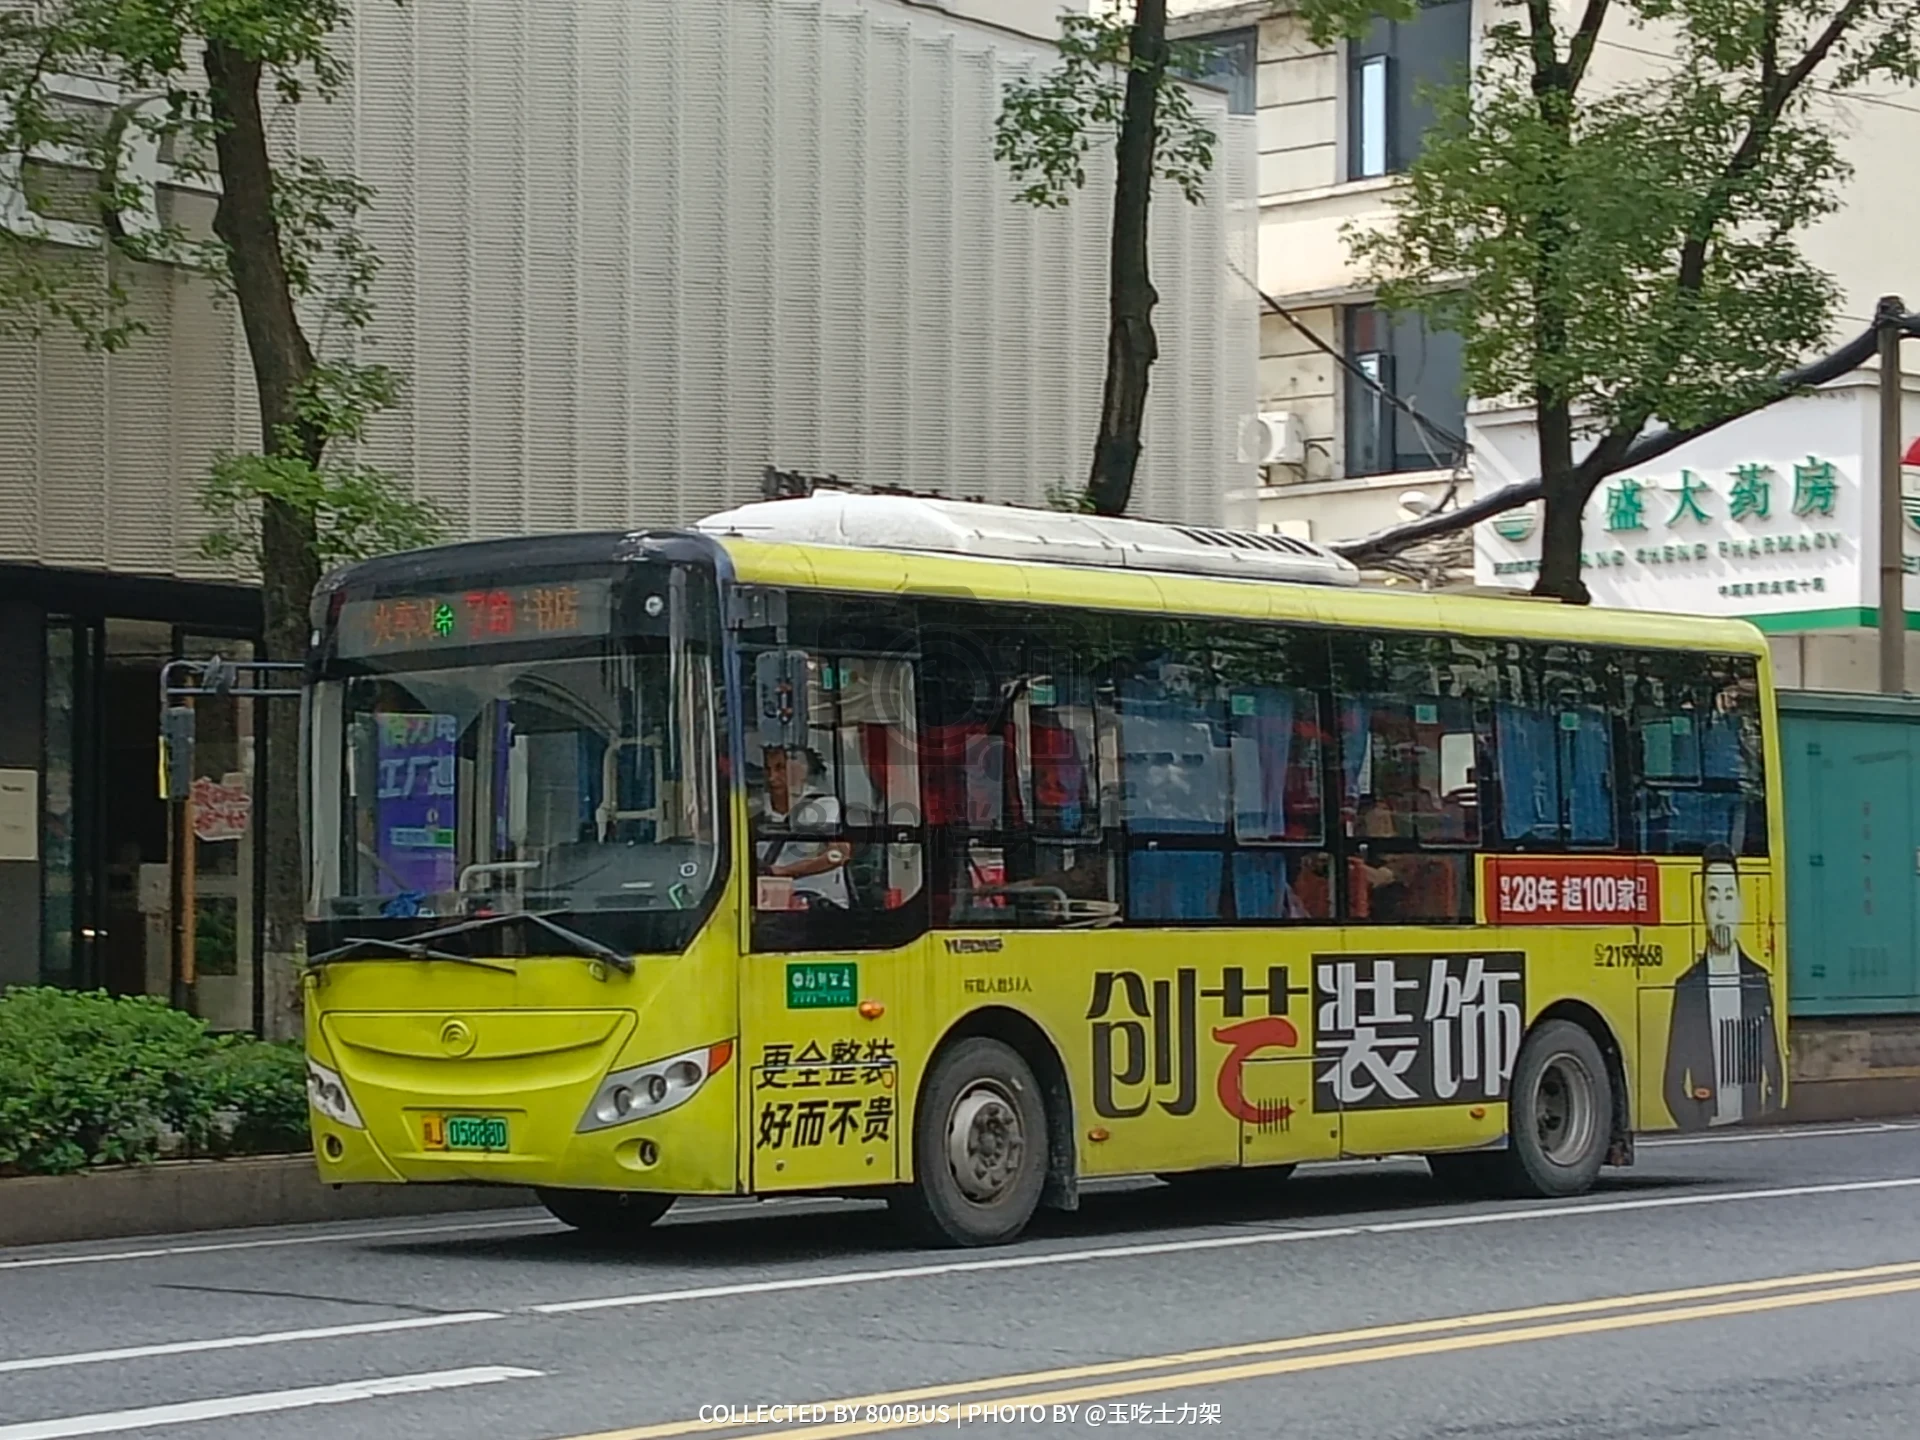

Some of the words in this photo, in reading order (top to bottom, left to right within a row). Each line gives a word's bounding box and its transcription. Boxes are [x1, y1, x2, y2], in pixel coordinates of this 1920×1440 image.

[1603, 456, 1841, 532] 盛大药房
[1718, 531, 1842, 560] PHARMACY
[756, 1038, 895, 1090] 更全整装
[1086, 958, 1521, 1124] 创艺装饰
[756, 1096, 893, 1149] 好而不贵
